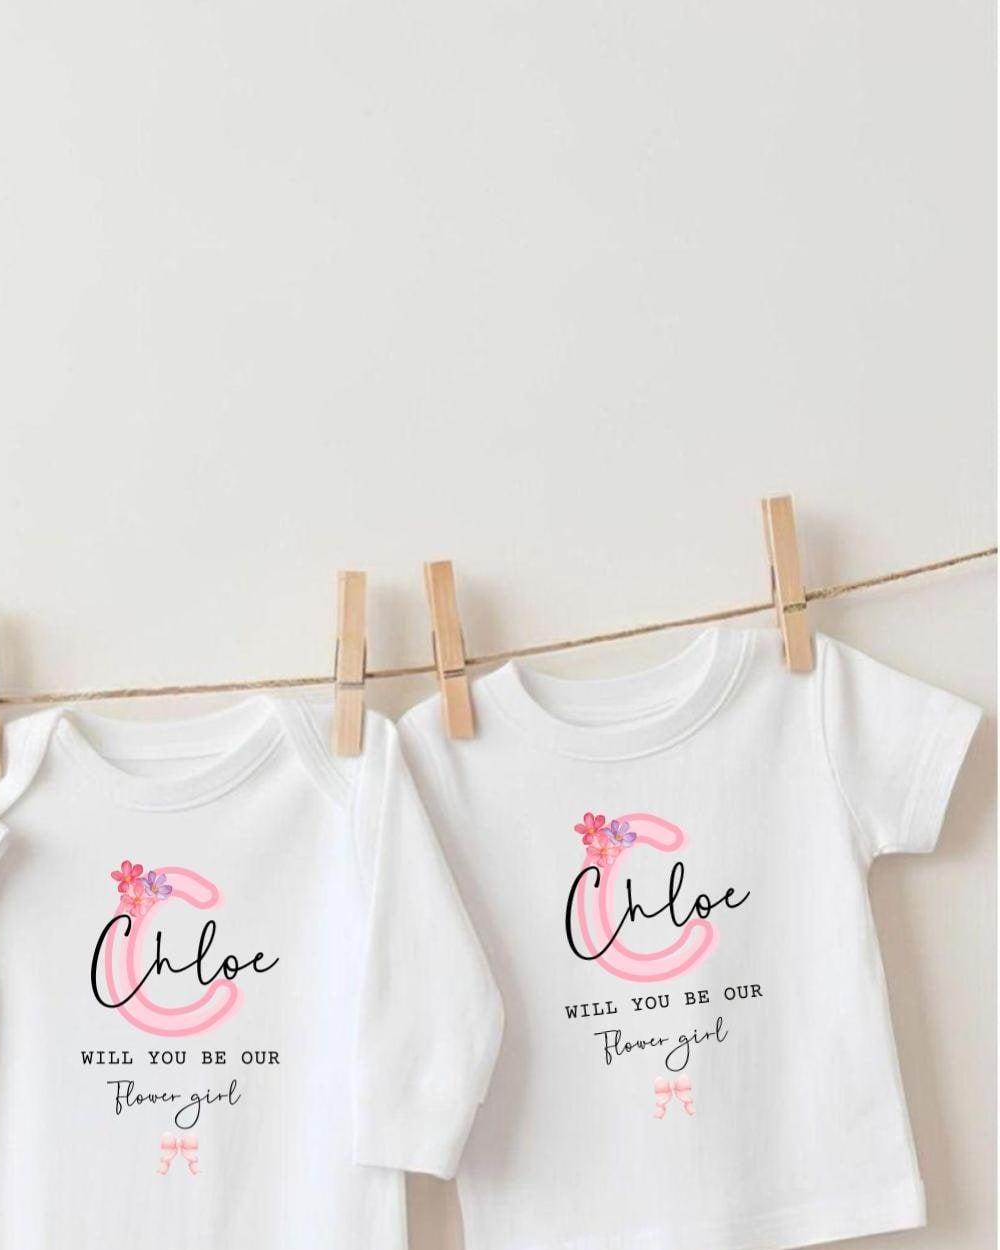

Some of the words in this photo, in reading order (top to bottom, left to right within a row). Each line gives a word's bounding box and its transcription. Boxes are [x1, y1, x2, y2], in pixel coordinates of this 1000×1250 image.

[565, 861, 750, 960] Chloe
[91, 914, 279, 1008] Chloe
[565, 1001, 618, 1019] WILL
[632, 995, 670, 1012] YOU
[685, 990, 709, 1006] BE
[724, 984, 763, 1000] OUR
[81, 1051, 133, 1064] WILL
[150, 1051, 186, 1064] YOU
[201, 1051, 226, 1064] BE
[241, 1051, 280, 1064] OUR
[594, 1030, 669, 1065] Flower
[665, 1017, 728, 1072] girl
[107, 1080, 181, 1115] Flower
[175, 1079, 241, 1129] girl
